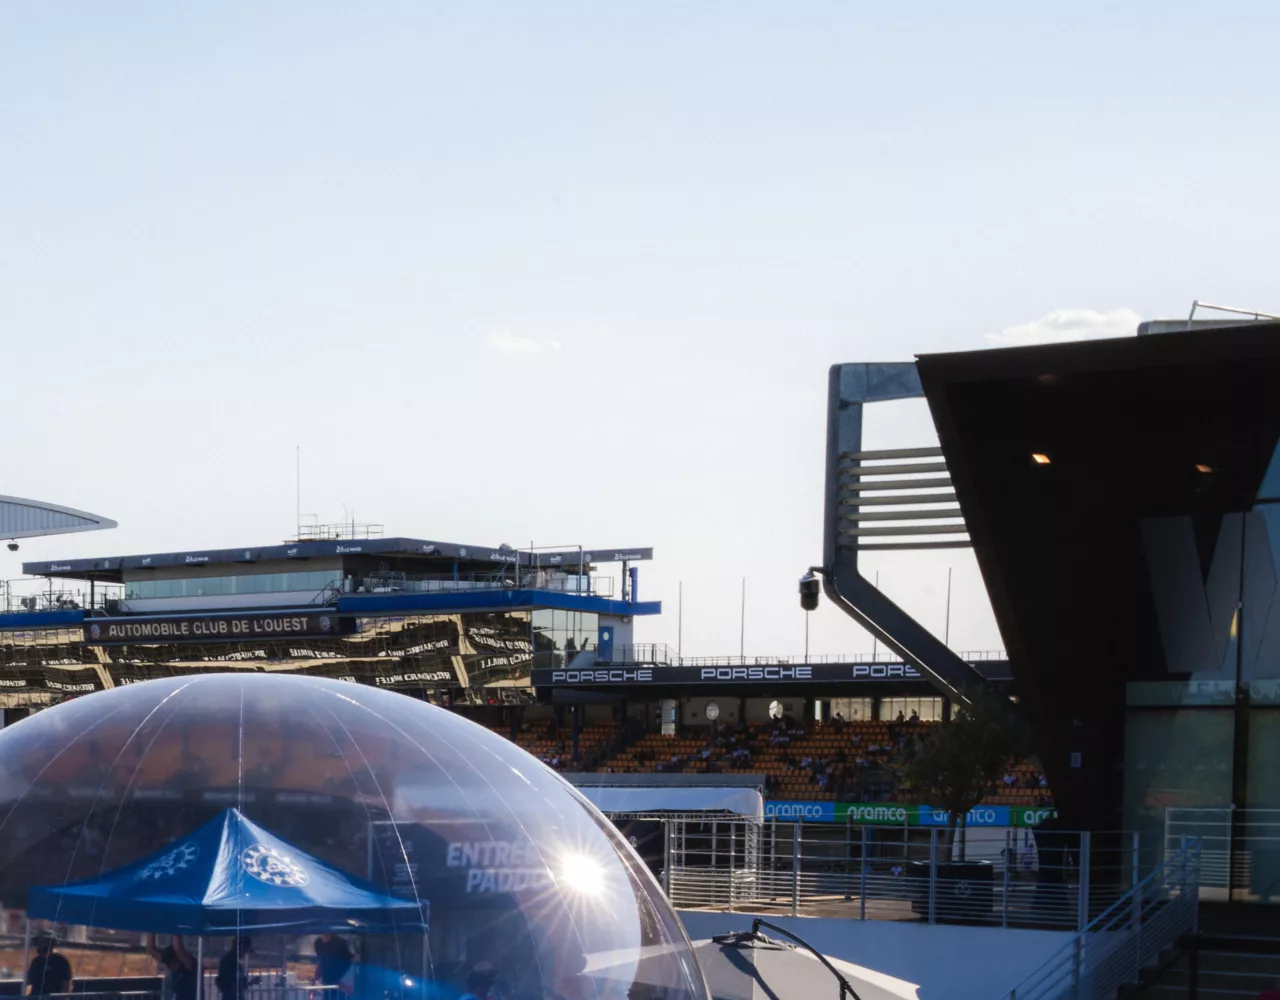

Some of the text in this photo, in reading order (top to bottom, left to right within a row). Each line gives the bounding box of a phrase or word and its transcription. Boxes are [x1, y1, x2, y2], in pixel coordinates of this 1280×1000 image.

[109, 617, 308, 637] AUTOMOBILE CLUB DE L'OUEST
[552, 669, 652, 682] PORSCHE
[701, 666, 812, 679] PORSCHE
[853, 664, 920, 677] PORS
[765, 803, 822, 818] aramco
[847, 805, 906, 820] aramco
